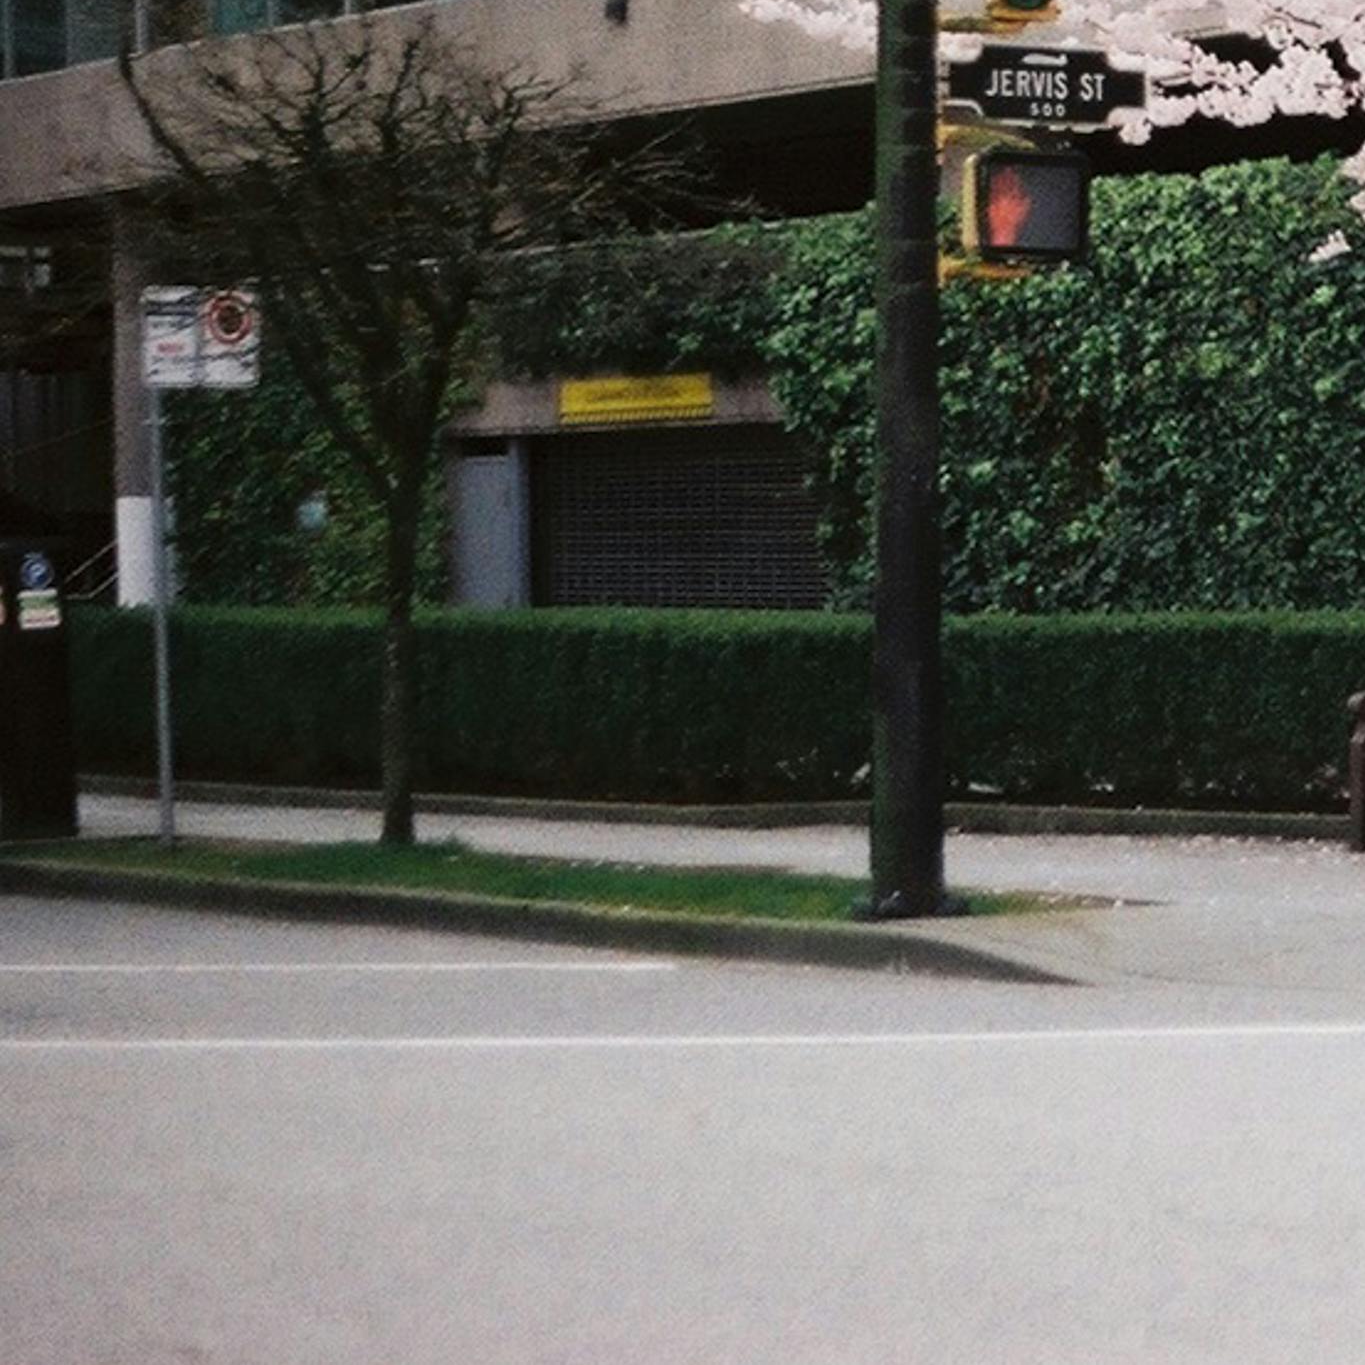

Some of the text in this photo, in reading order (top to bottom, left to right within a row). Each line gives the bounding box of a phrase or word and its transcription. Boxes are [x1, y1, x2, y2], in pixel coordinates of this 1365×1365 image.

[984, 68, 1106, 102] JERVIS ST
[1030, 101, 1066, 117] 500
